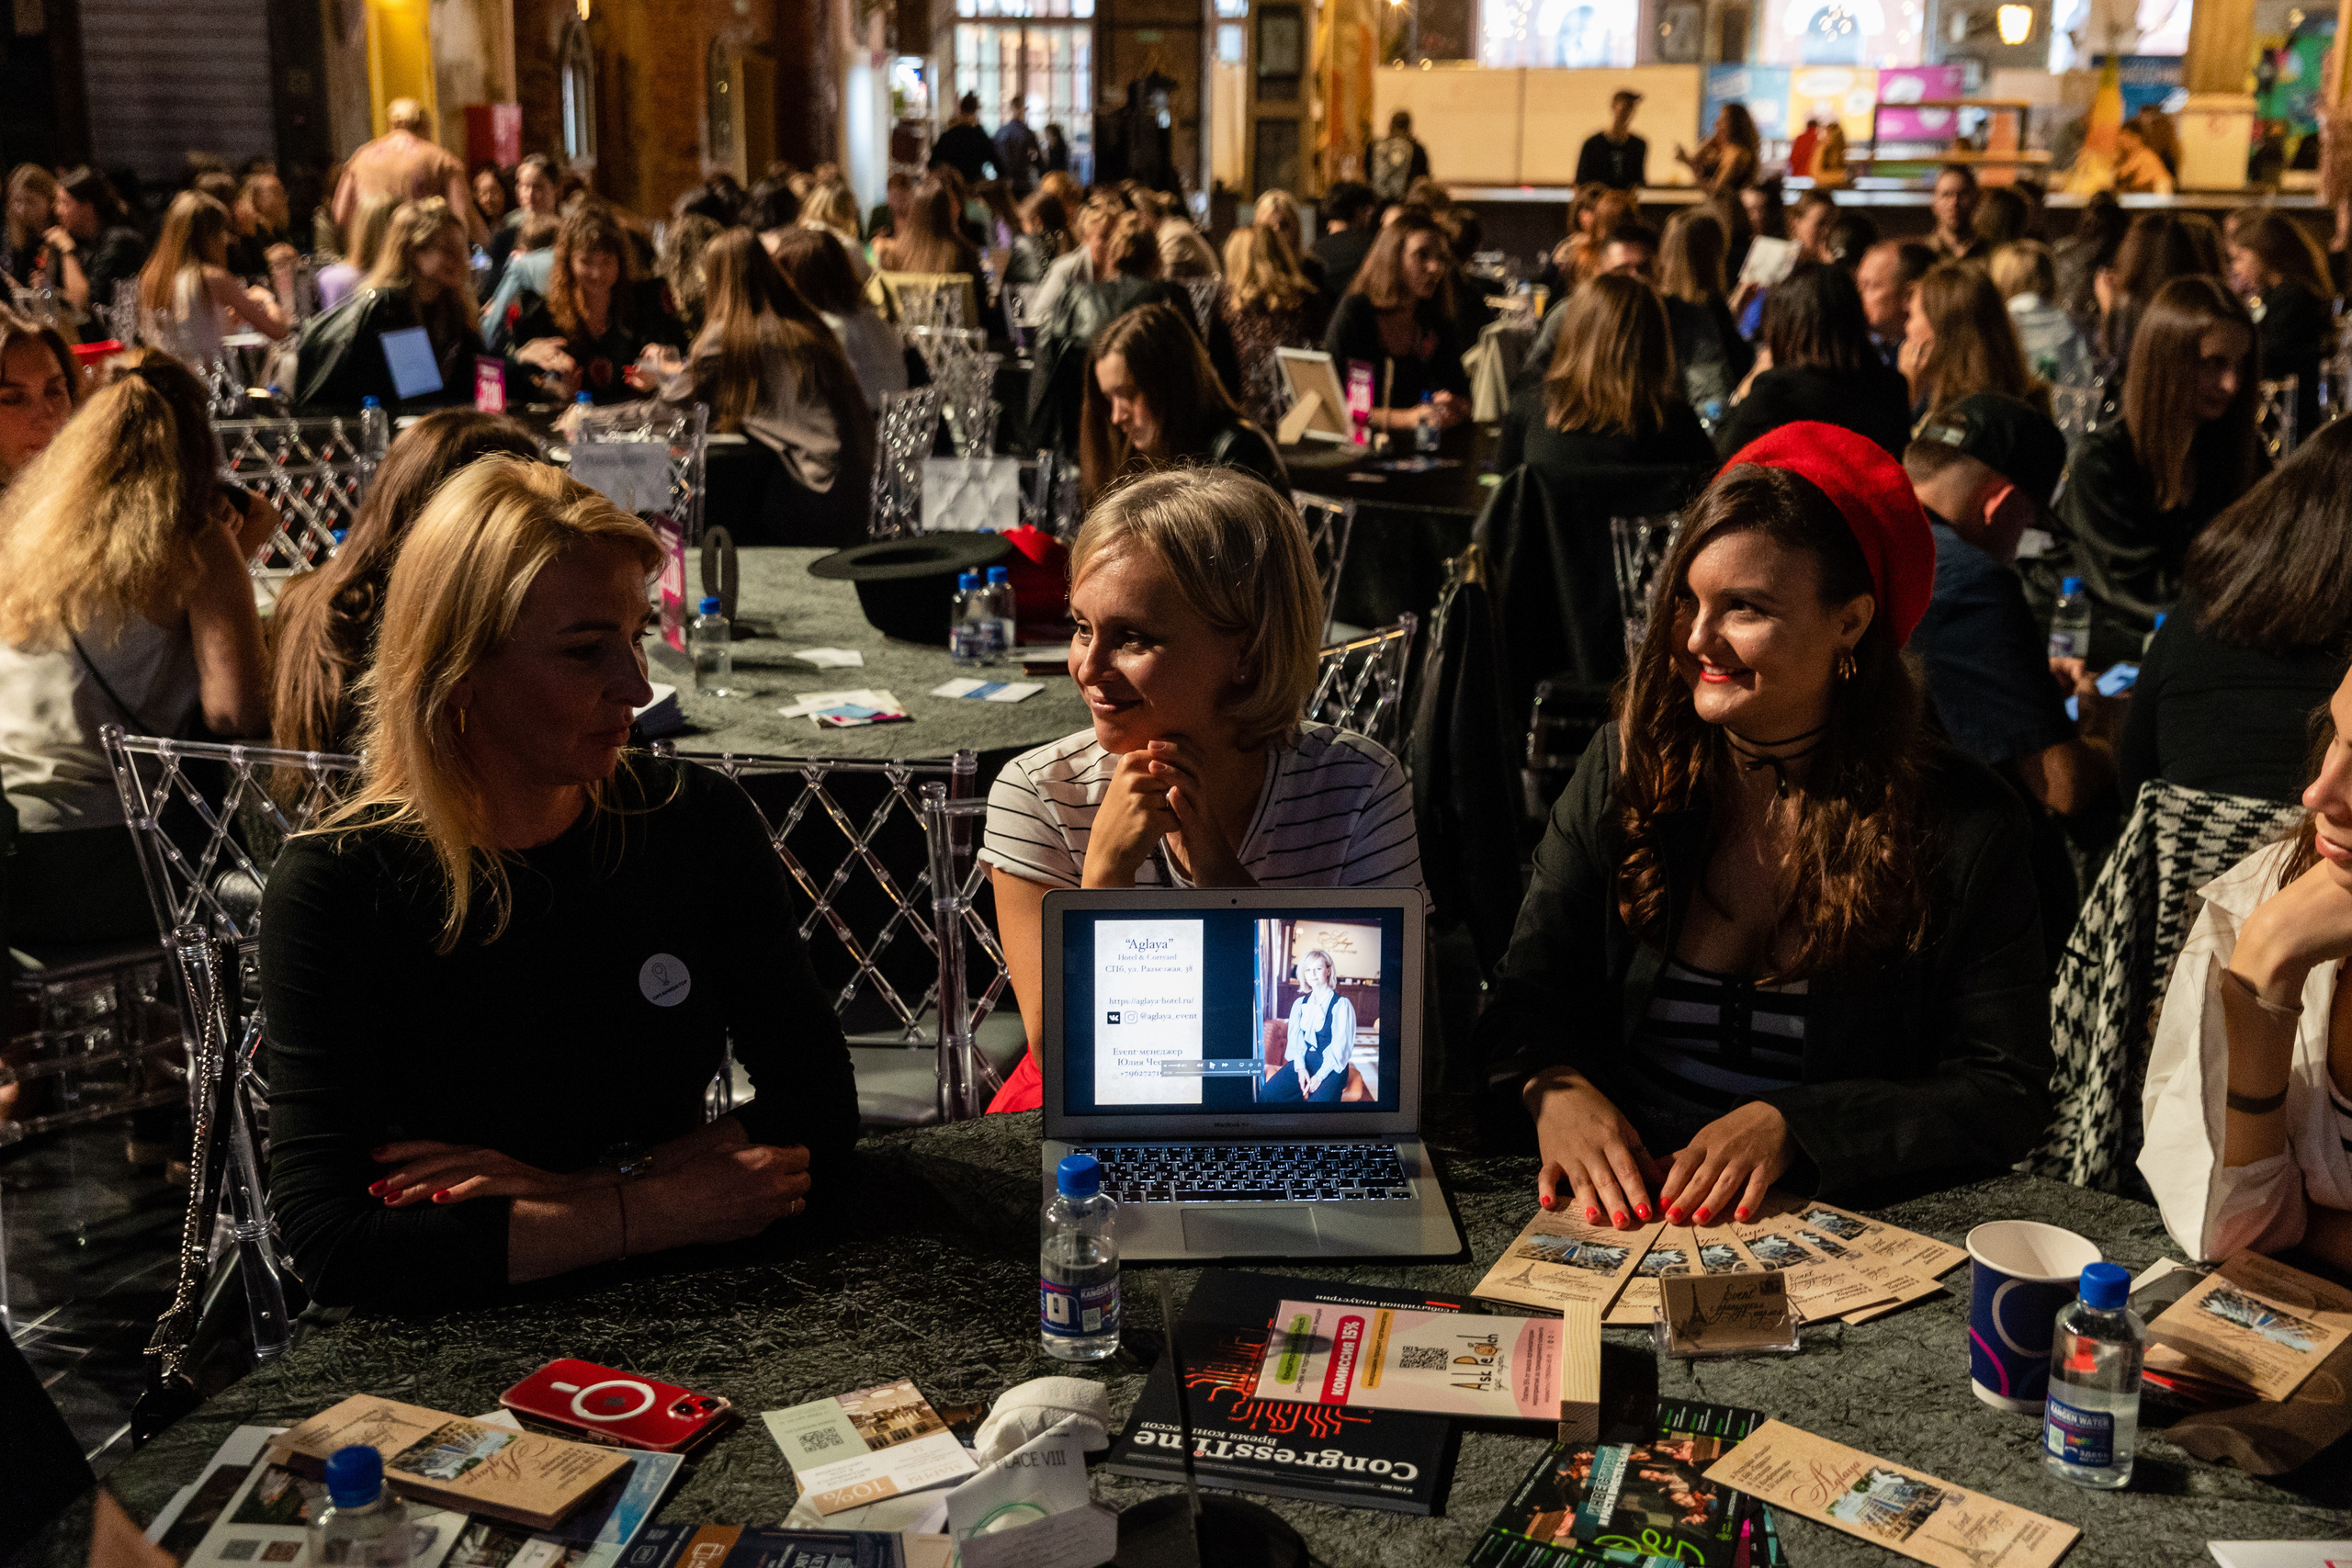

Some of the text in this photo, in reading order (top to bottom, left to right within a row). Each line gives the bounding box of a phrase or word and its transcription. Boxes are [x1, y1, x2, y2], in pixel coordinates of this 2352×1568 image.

[1113, 1047, 1183, 1057] Event-менеджер
[1117, 1057, 1145, 1066] Юлия
[1080, 1282, 1110, 1300] KANGEN
[1315, 1294, 1377, 1306] индустрии
[1723, 1283, 1757, 1304] Event
[1378, 1301, 1450, 1313] событийной
[1330, 1321, 1361, 1396] КОМИССИЯ 15%
[1450, 1333, 1499, 1392] Ask Peach
[2051, 1402, 2110, 1428] KANGEN WATER
[1140, 1421, 1278, 1446] Время конгессов
[1040, 1450, 1067, 1467] VIII
[822, 1476, 888, 1506] 10%
[1790, 1458, 1863, 1508] Aglaya
